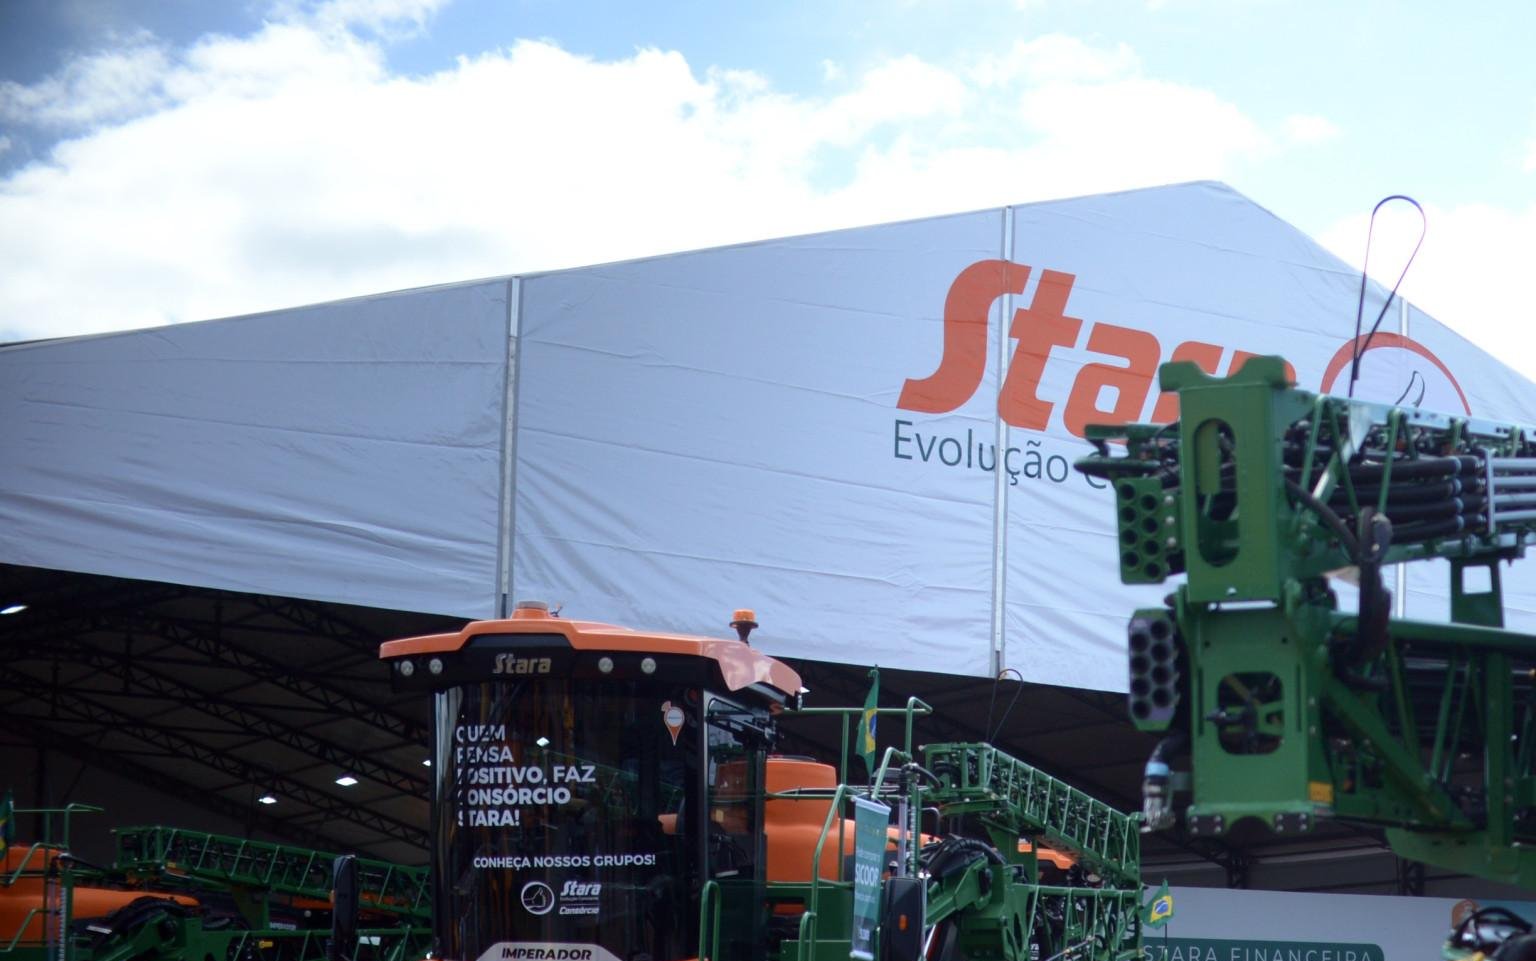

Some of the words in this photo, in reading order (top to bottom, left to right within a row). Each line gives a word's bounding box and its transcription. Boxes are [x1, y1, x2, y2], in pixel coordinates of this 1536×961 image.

[895, 258, 1297, 442] Star
[893, 418, 1070, 486] Evolução
[492, 652, 552, 675] Stara
[456, 724, 506, 743] QUEM
[553, 765, 597, 783] FAZ
[457, 784, 572, 806] ONSÓRCIO
[473, 856, 531, 871] CONHEÇA
[533, 855, 591, 869] NOSSOS
[593, 854, 656, 867] GRUPOS!
[560, 880, 602, 897] Stara
[501, 947, 592, 961] IMPERADOR
